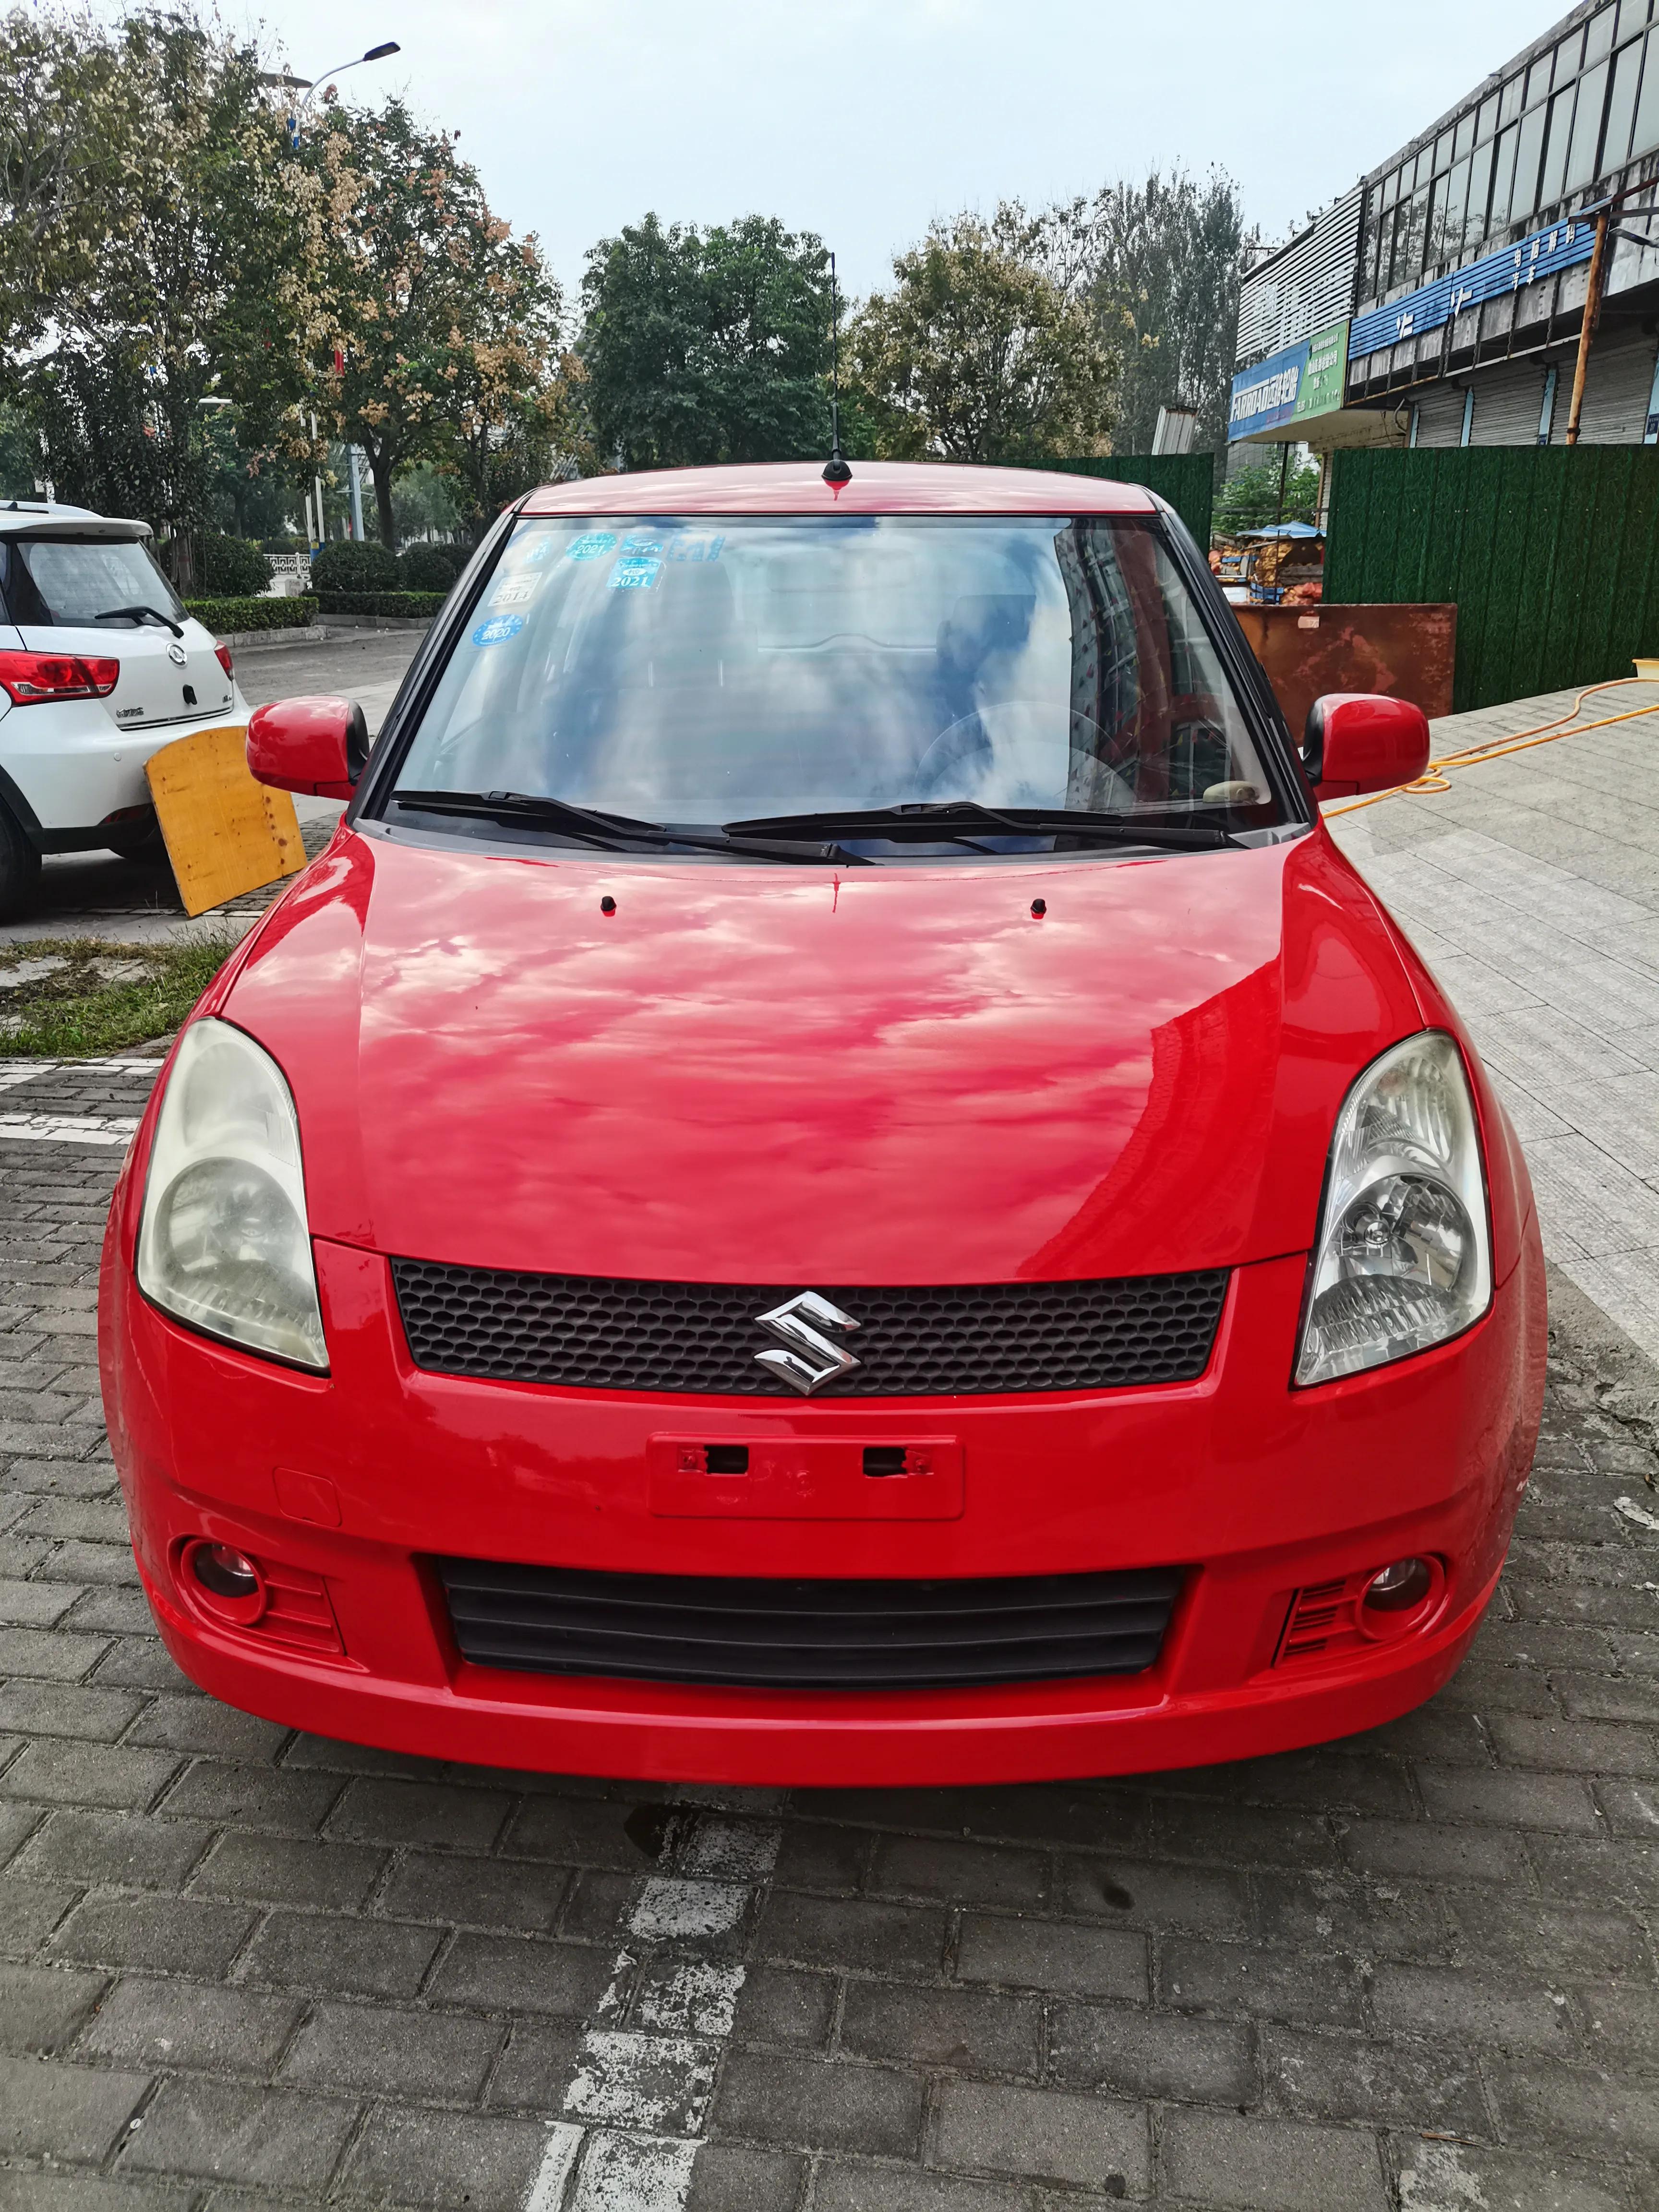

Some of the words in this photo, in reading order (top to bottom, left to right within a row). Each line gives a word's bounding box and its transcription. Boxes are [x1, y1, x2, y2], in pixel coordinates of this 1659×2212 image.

[1514, 224, 1575, 267] 电脑解码
[1512, 264, 1536, 291] 汽车
[1230, 378, 1270, 423] FARROAD
[575, 544, 605, 554] 2021
[611, 576, 650, 587] 2021
[481, 627, 511, 641] 2020
